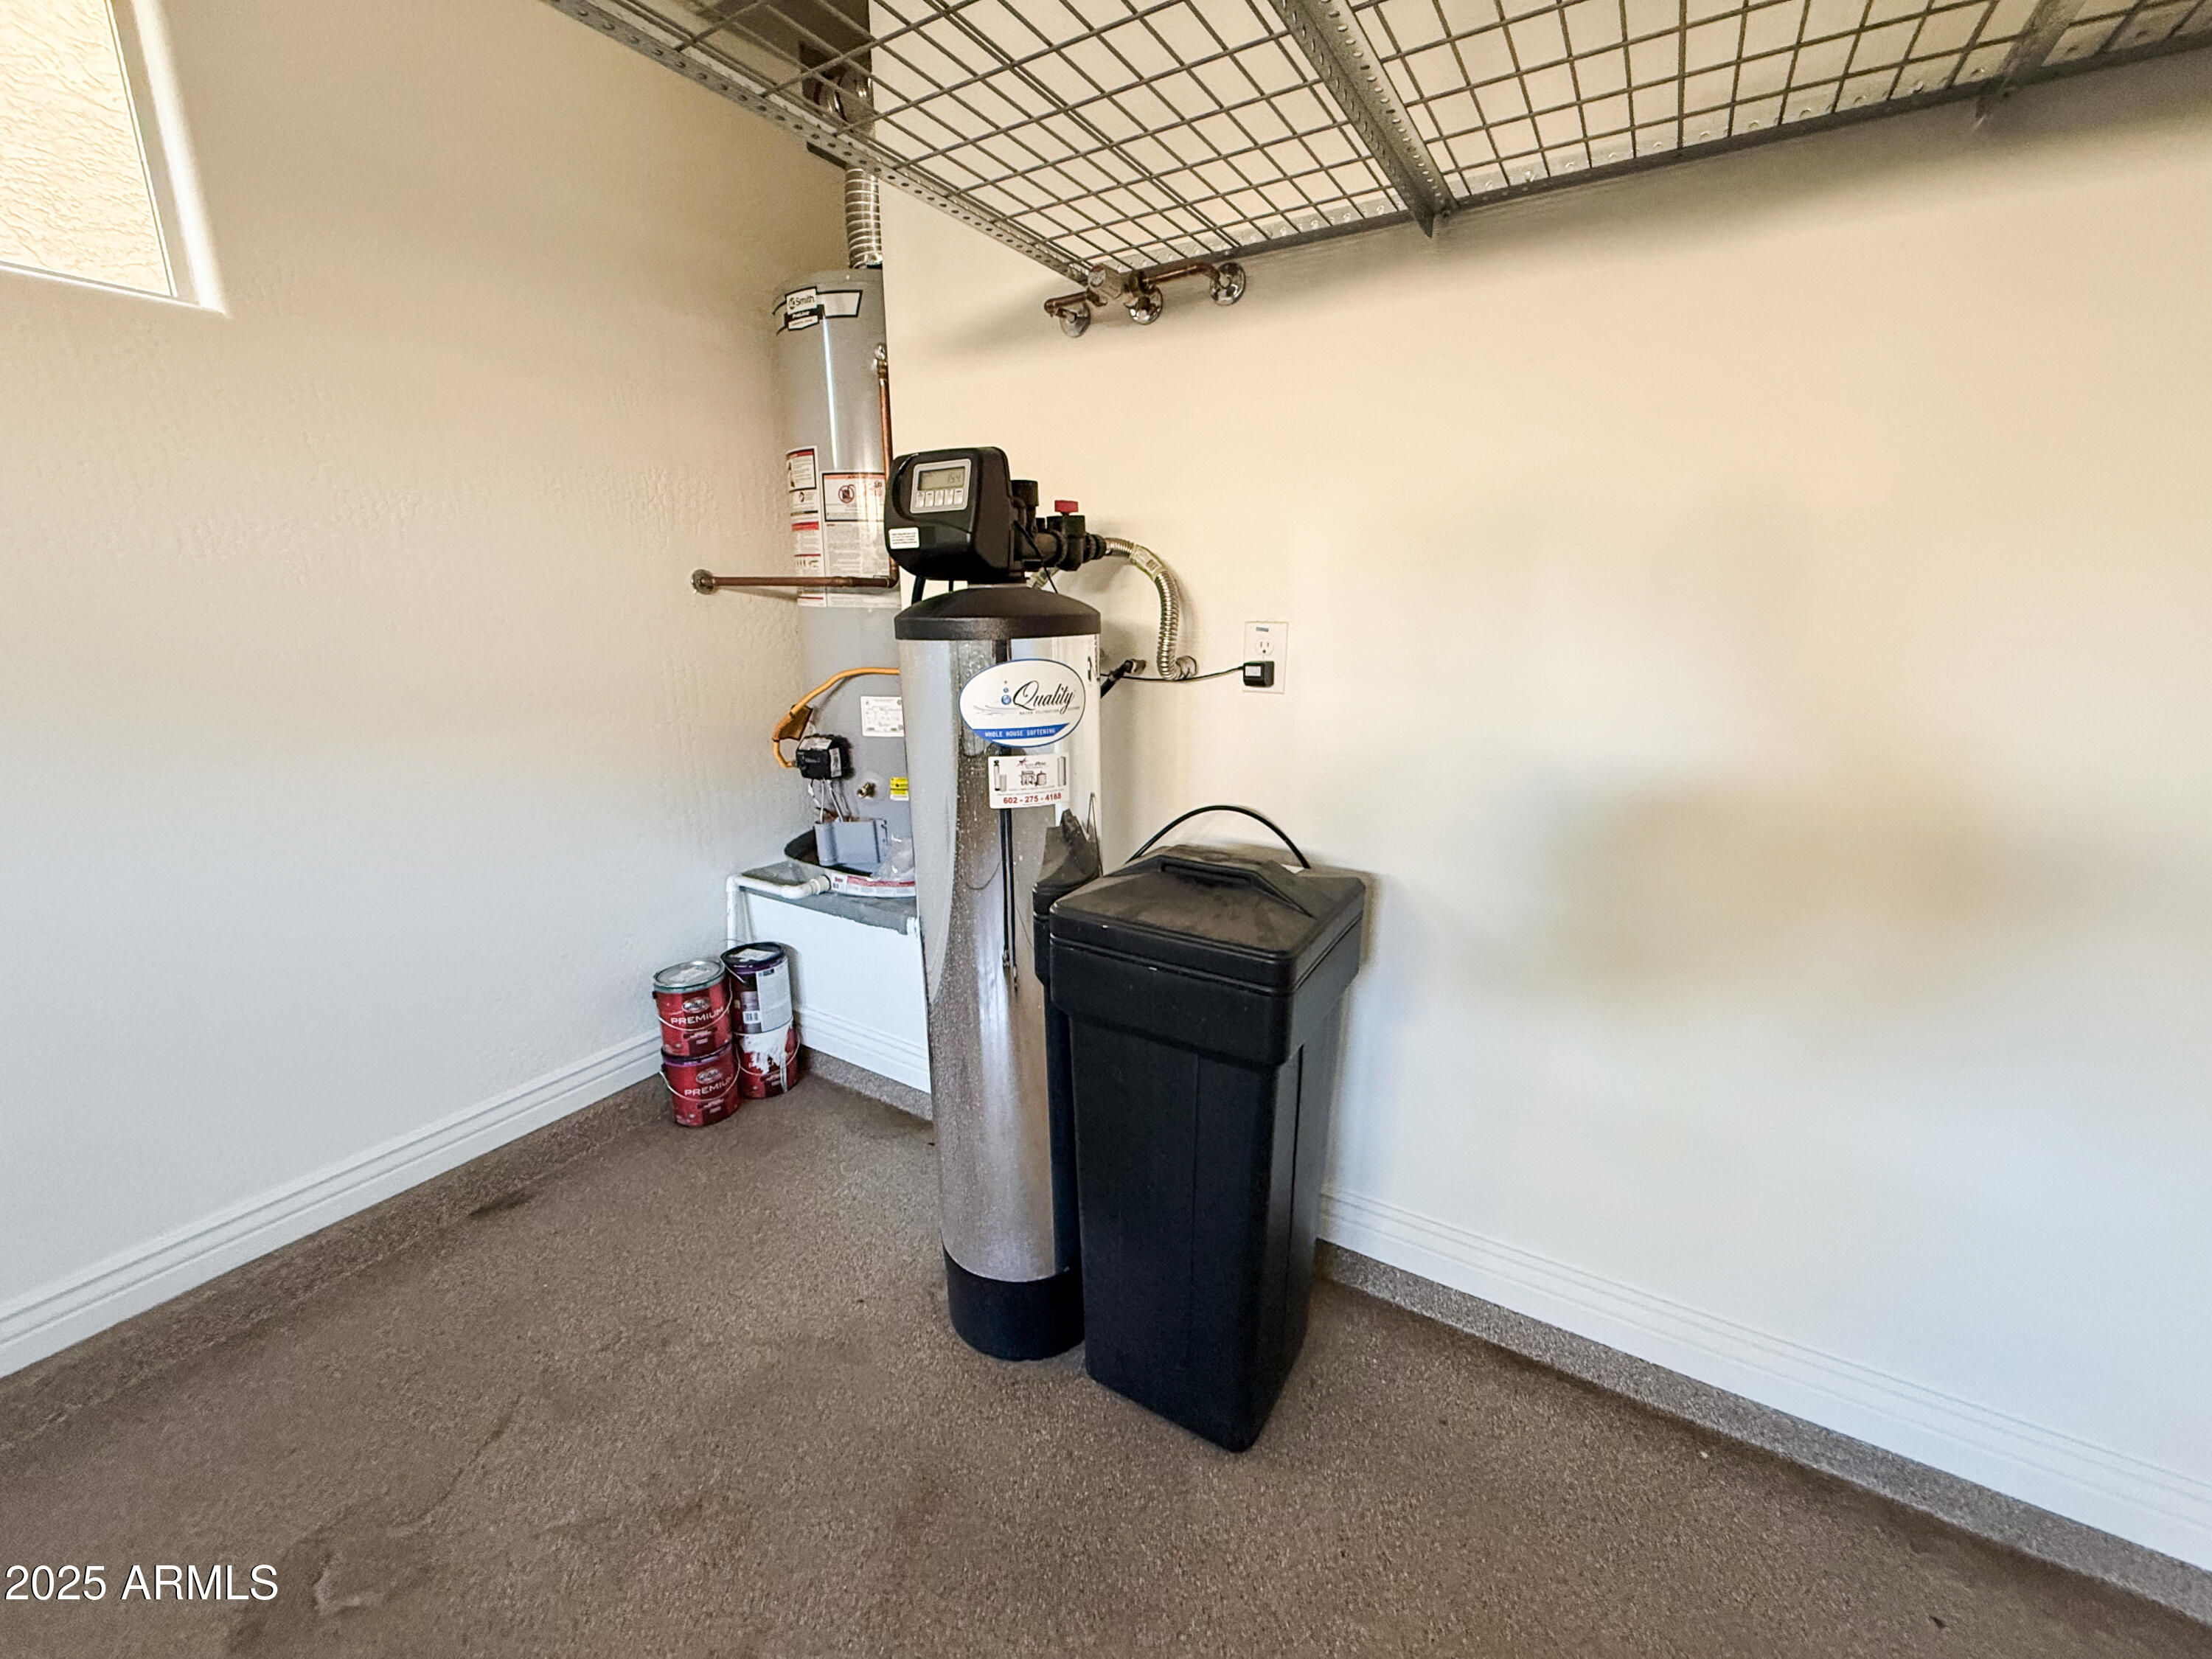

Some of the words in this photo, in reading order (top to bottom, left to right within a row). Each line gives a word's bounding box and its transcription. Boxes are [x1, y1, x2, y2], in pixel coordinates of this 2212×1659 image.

[796, 295, 815, 306] Smith
[1013, 680, 1074, 714] Quality
[1026, 727, 1056, 737] SOFTENING
[1025, 795, 1039, 803] 275
[670, 1006, 724, 1025] PREMIUM
